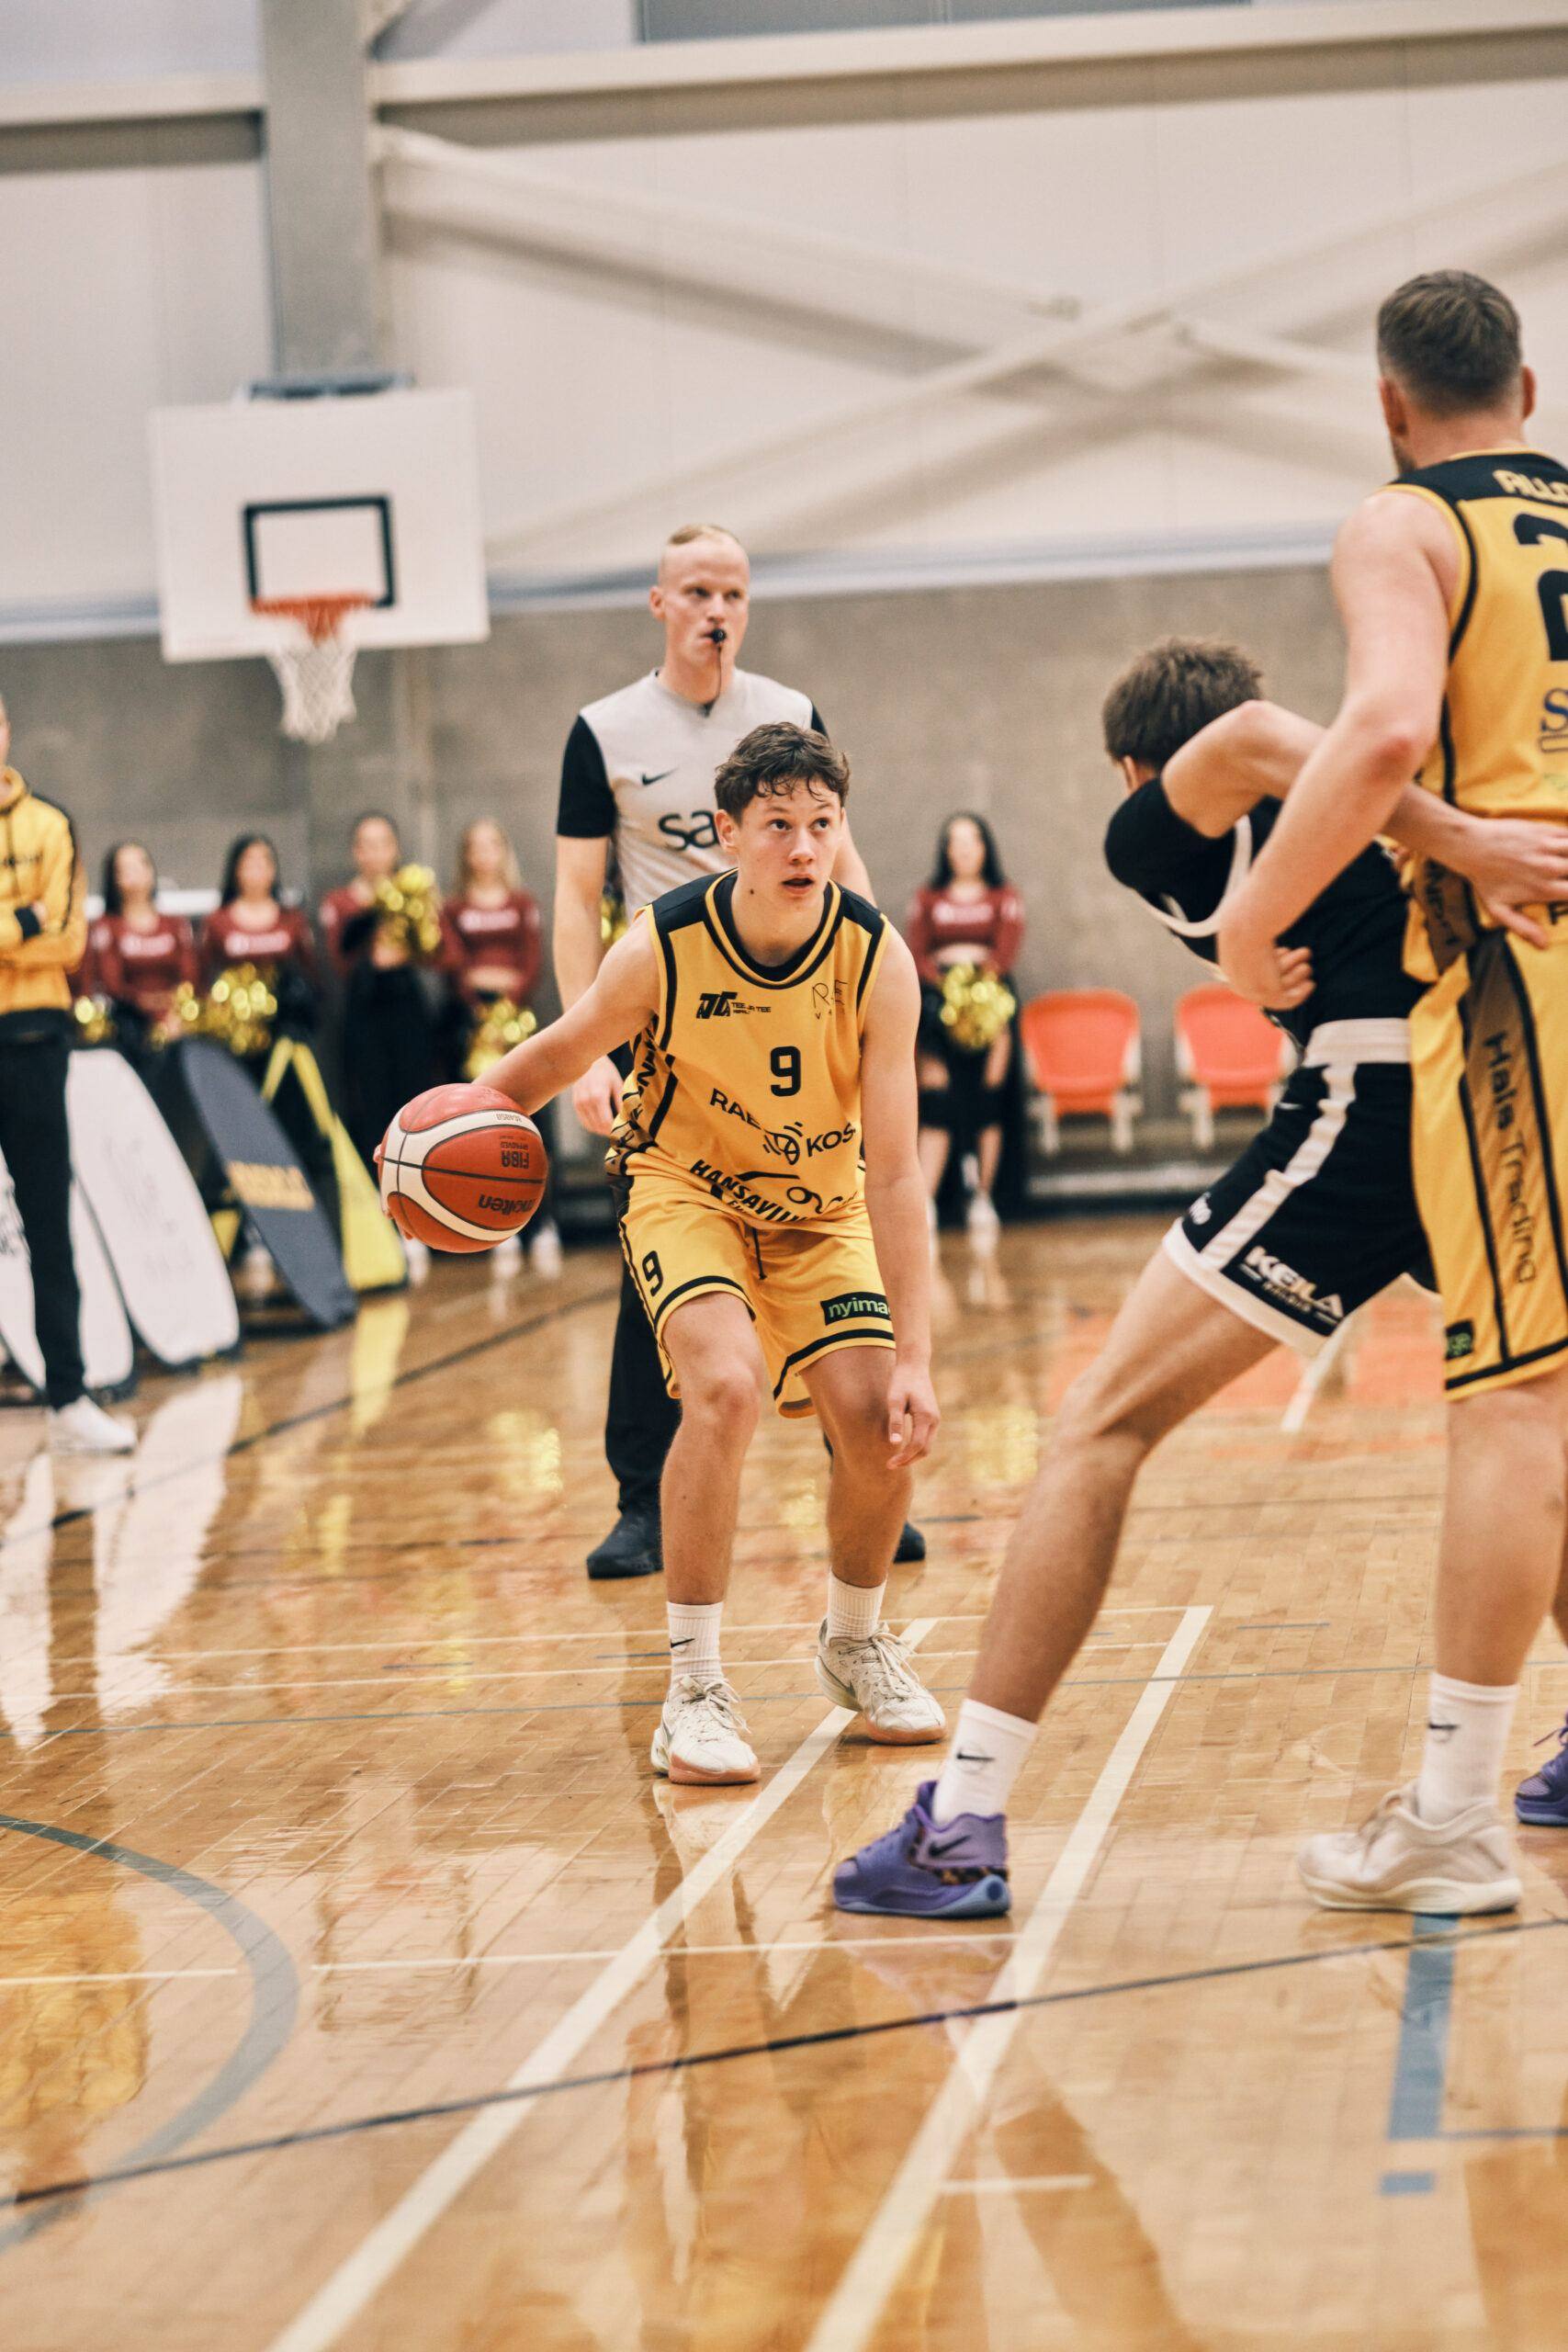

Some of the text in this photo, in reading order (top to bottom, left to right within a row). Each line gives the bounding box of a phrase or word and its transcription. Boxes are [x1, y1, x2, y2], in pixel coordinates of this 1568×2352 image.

[770, 1046, 801, 1097] 9
[710, 1088, 761, 1130] RAE
[502, 1150, 529, 1169] FIBA
[479, 1194, 536, 1216] molten
[642, 1250, 663, 1297] 9
[829, 1297, 891, 1317] nyima
